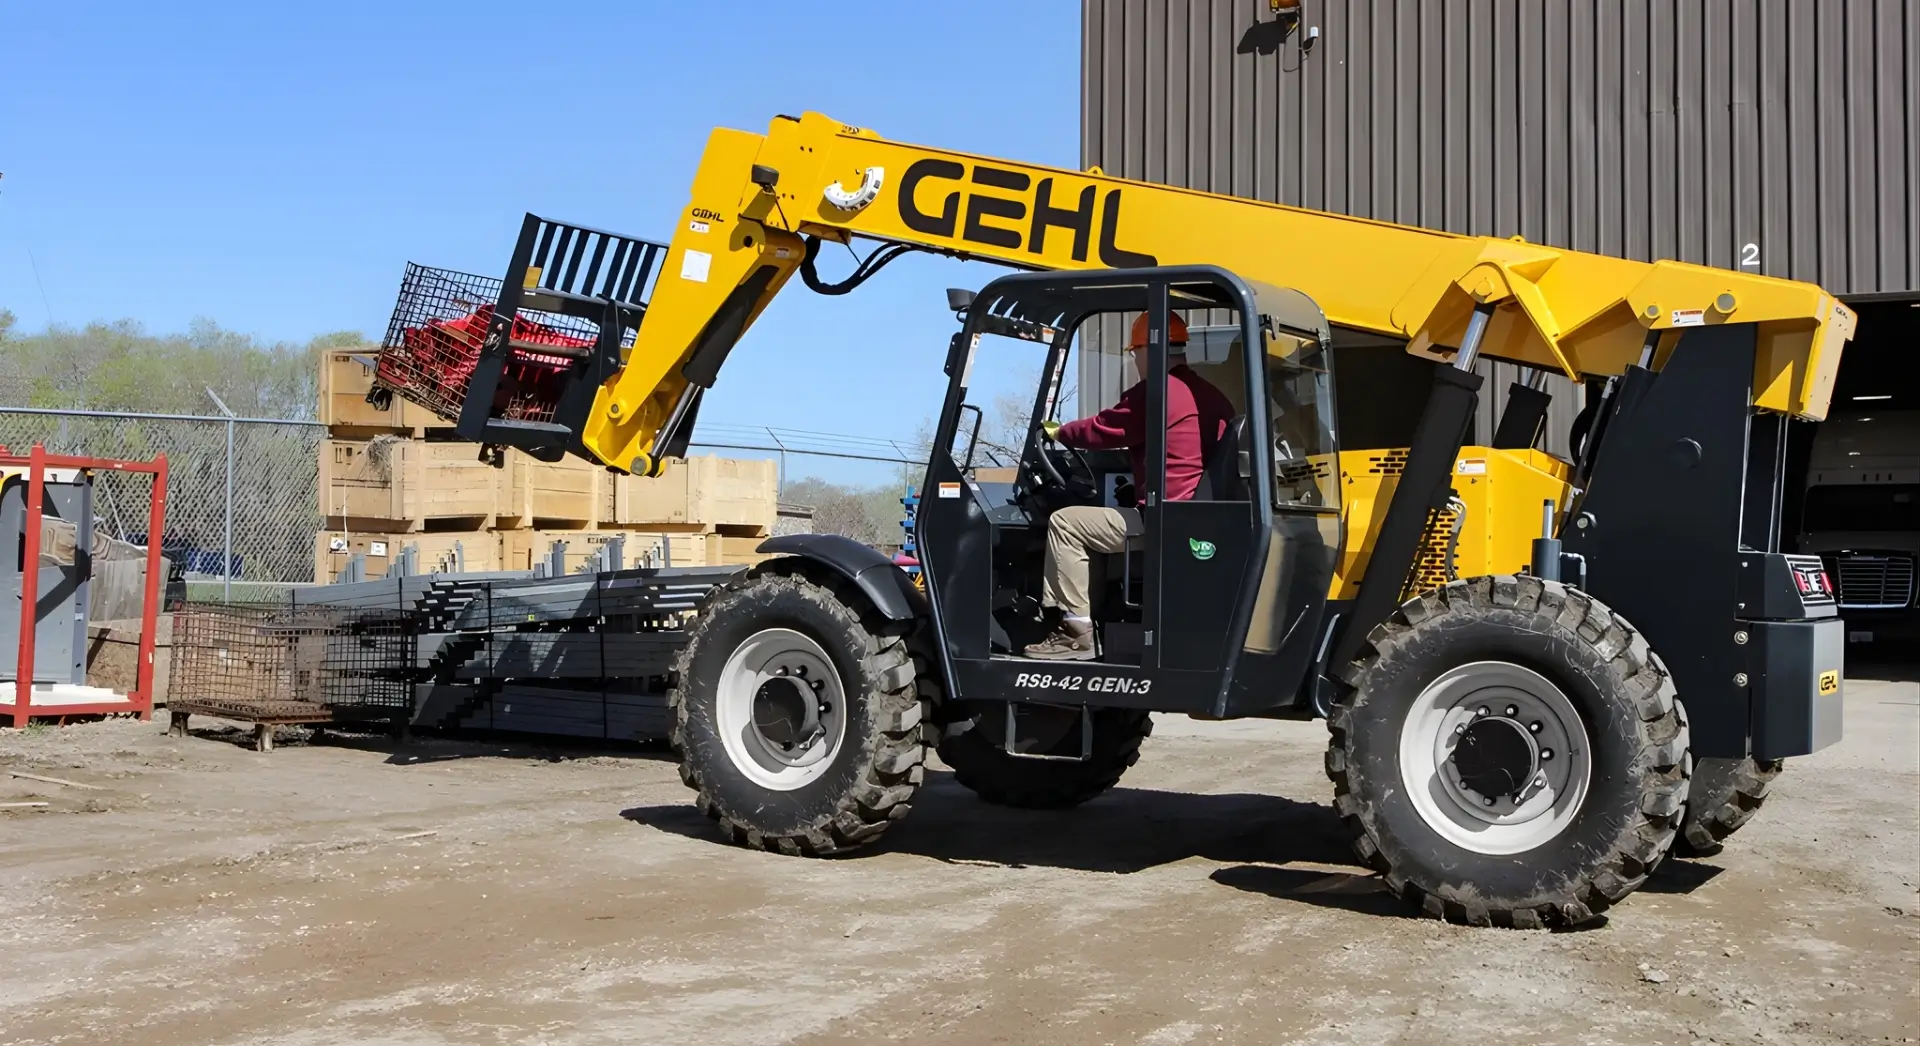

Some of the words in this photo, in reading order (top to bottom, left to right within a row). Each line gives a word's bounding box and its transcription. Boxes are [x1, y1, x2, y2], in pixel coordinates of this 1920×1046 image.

[898, 158, 1158, 269] GEHL
[1742, 243, 1760, 266] 2
[1015, 673, 1083, 690] RS8-42
[1087, 676, 1152, 694] GEN:3
